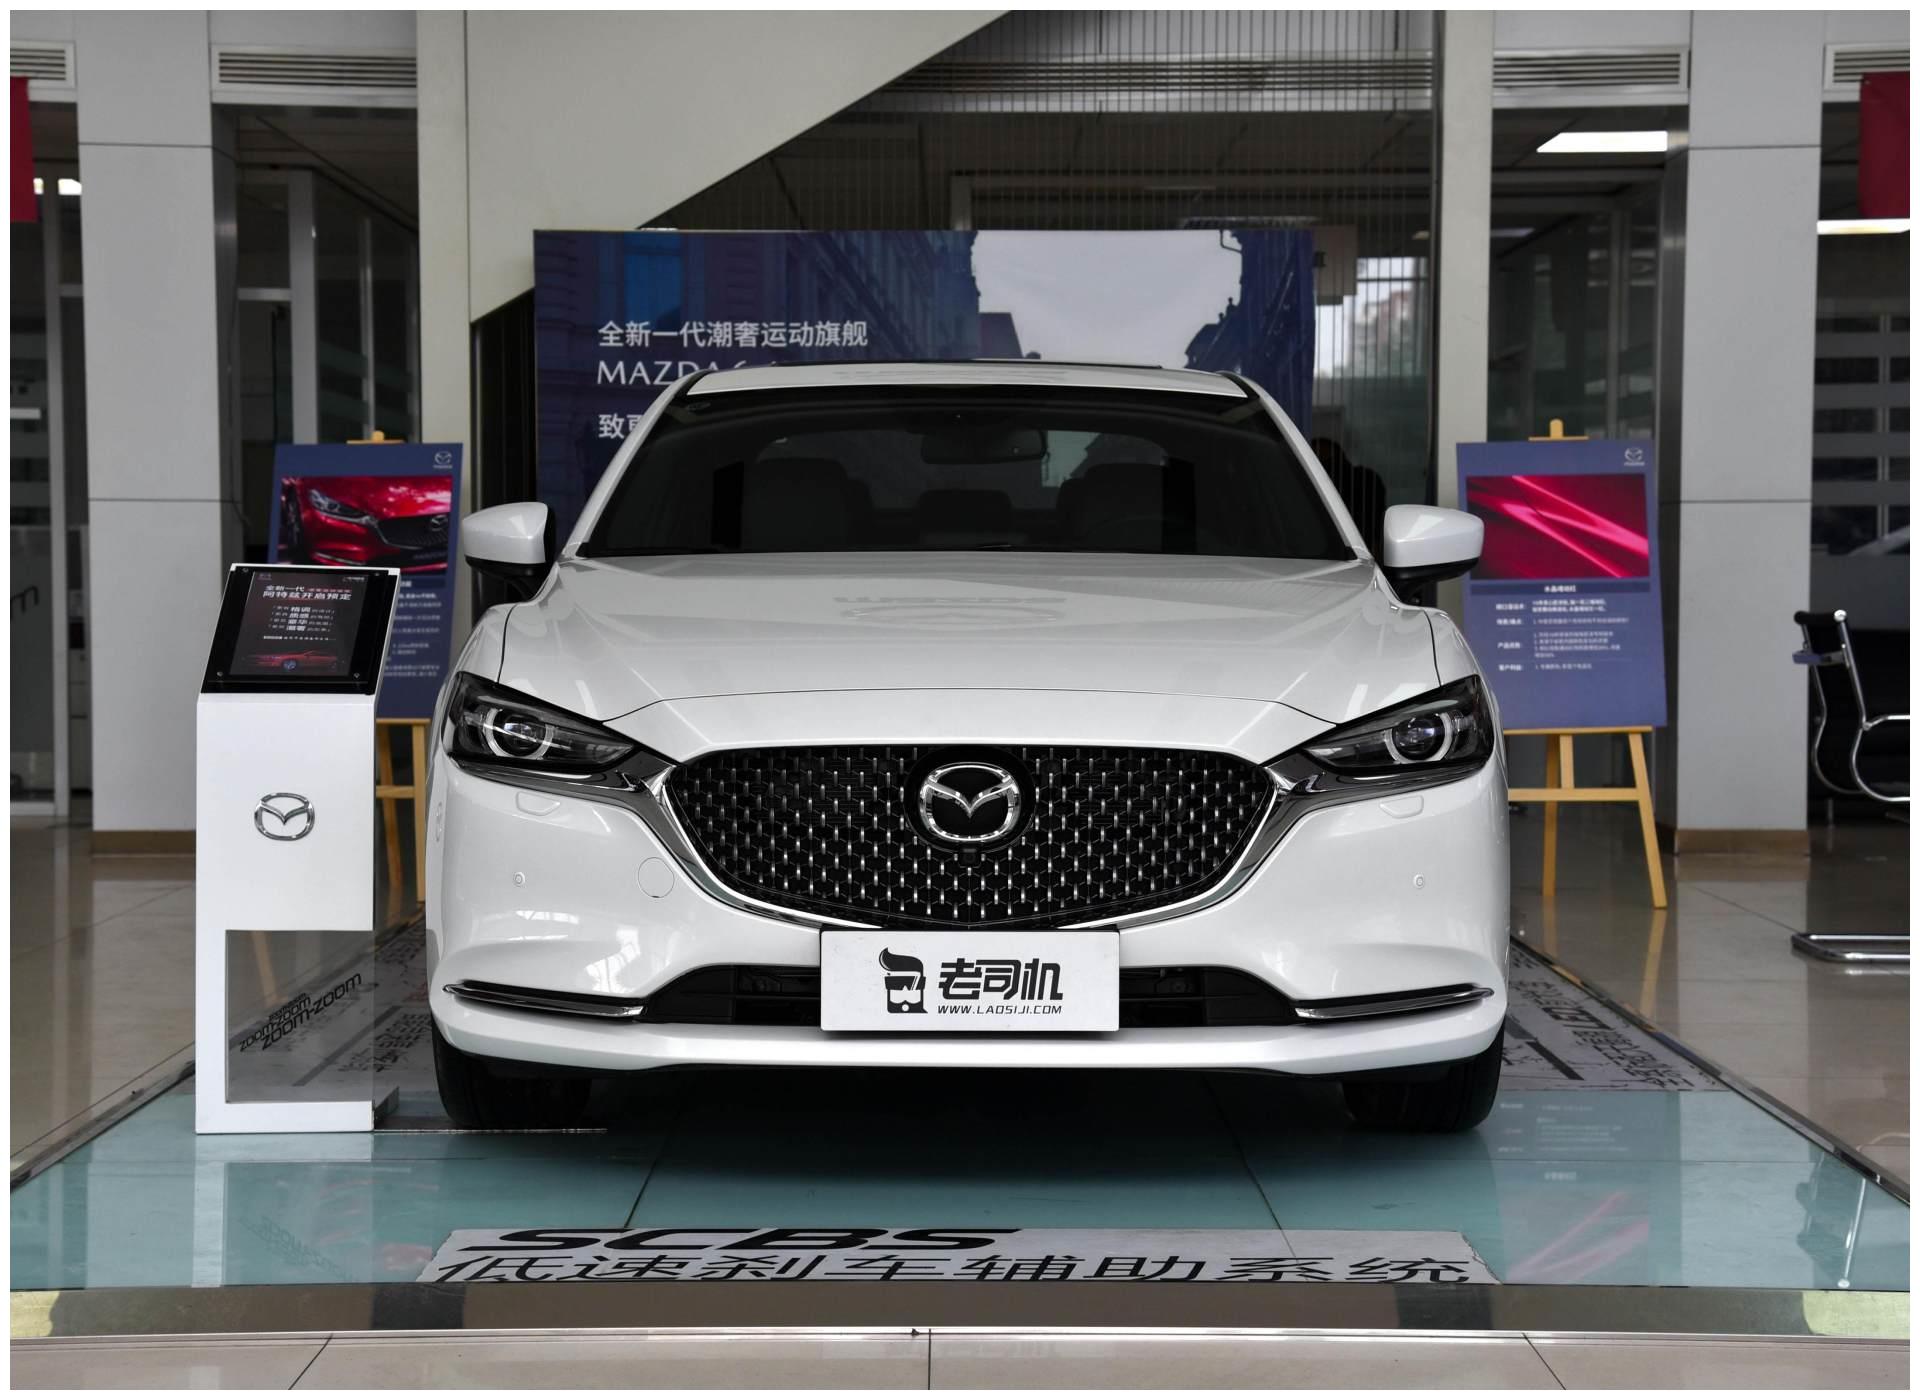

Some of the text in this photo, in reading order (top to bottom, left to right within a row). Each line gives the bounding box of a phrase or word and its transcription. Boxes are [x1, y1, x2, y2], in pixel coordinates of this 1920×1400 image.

[597, 320, 869, 348] 全新一代潮奢运动旗舰
[938, 957, 1064, 1001] 老司机
[261, 972, 363, 1051] zoom-zoom
[936, 1004, 1063, 1015] WWW.LAOSIJI.COM
[460, 1228, 1023, 1252] SCBS
[434, 1253, 1471, 1284] 低速刹车辅助系统
